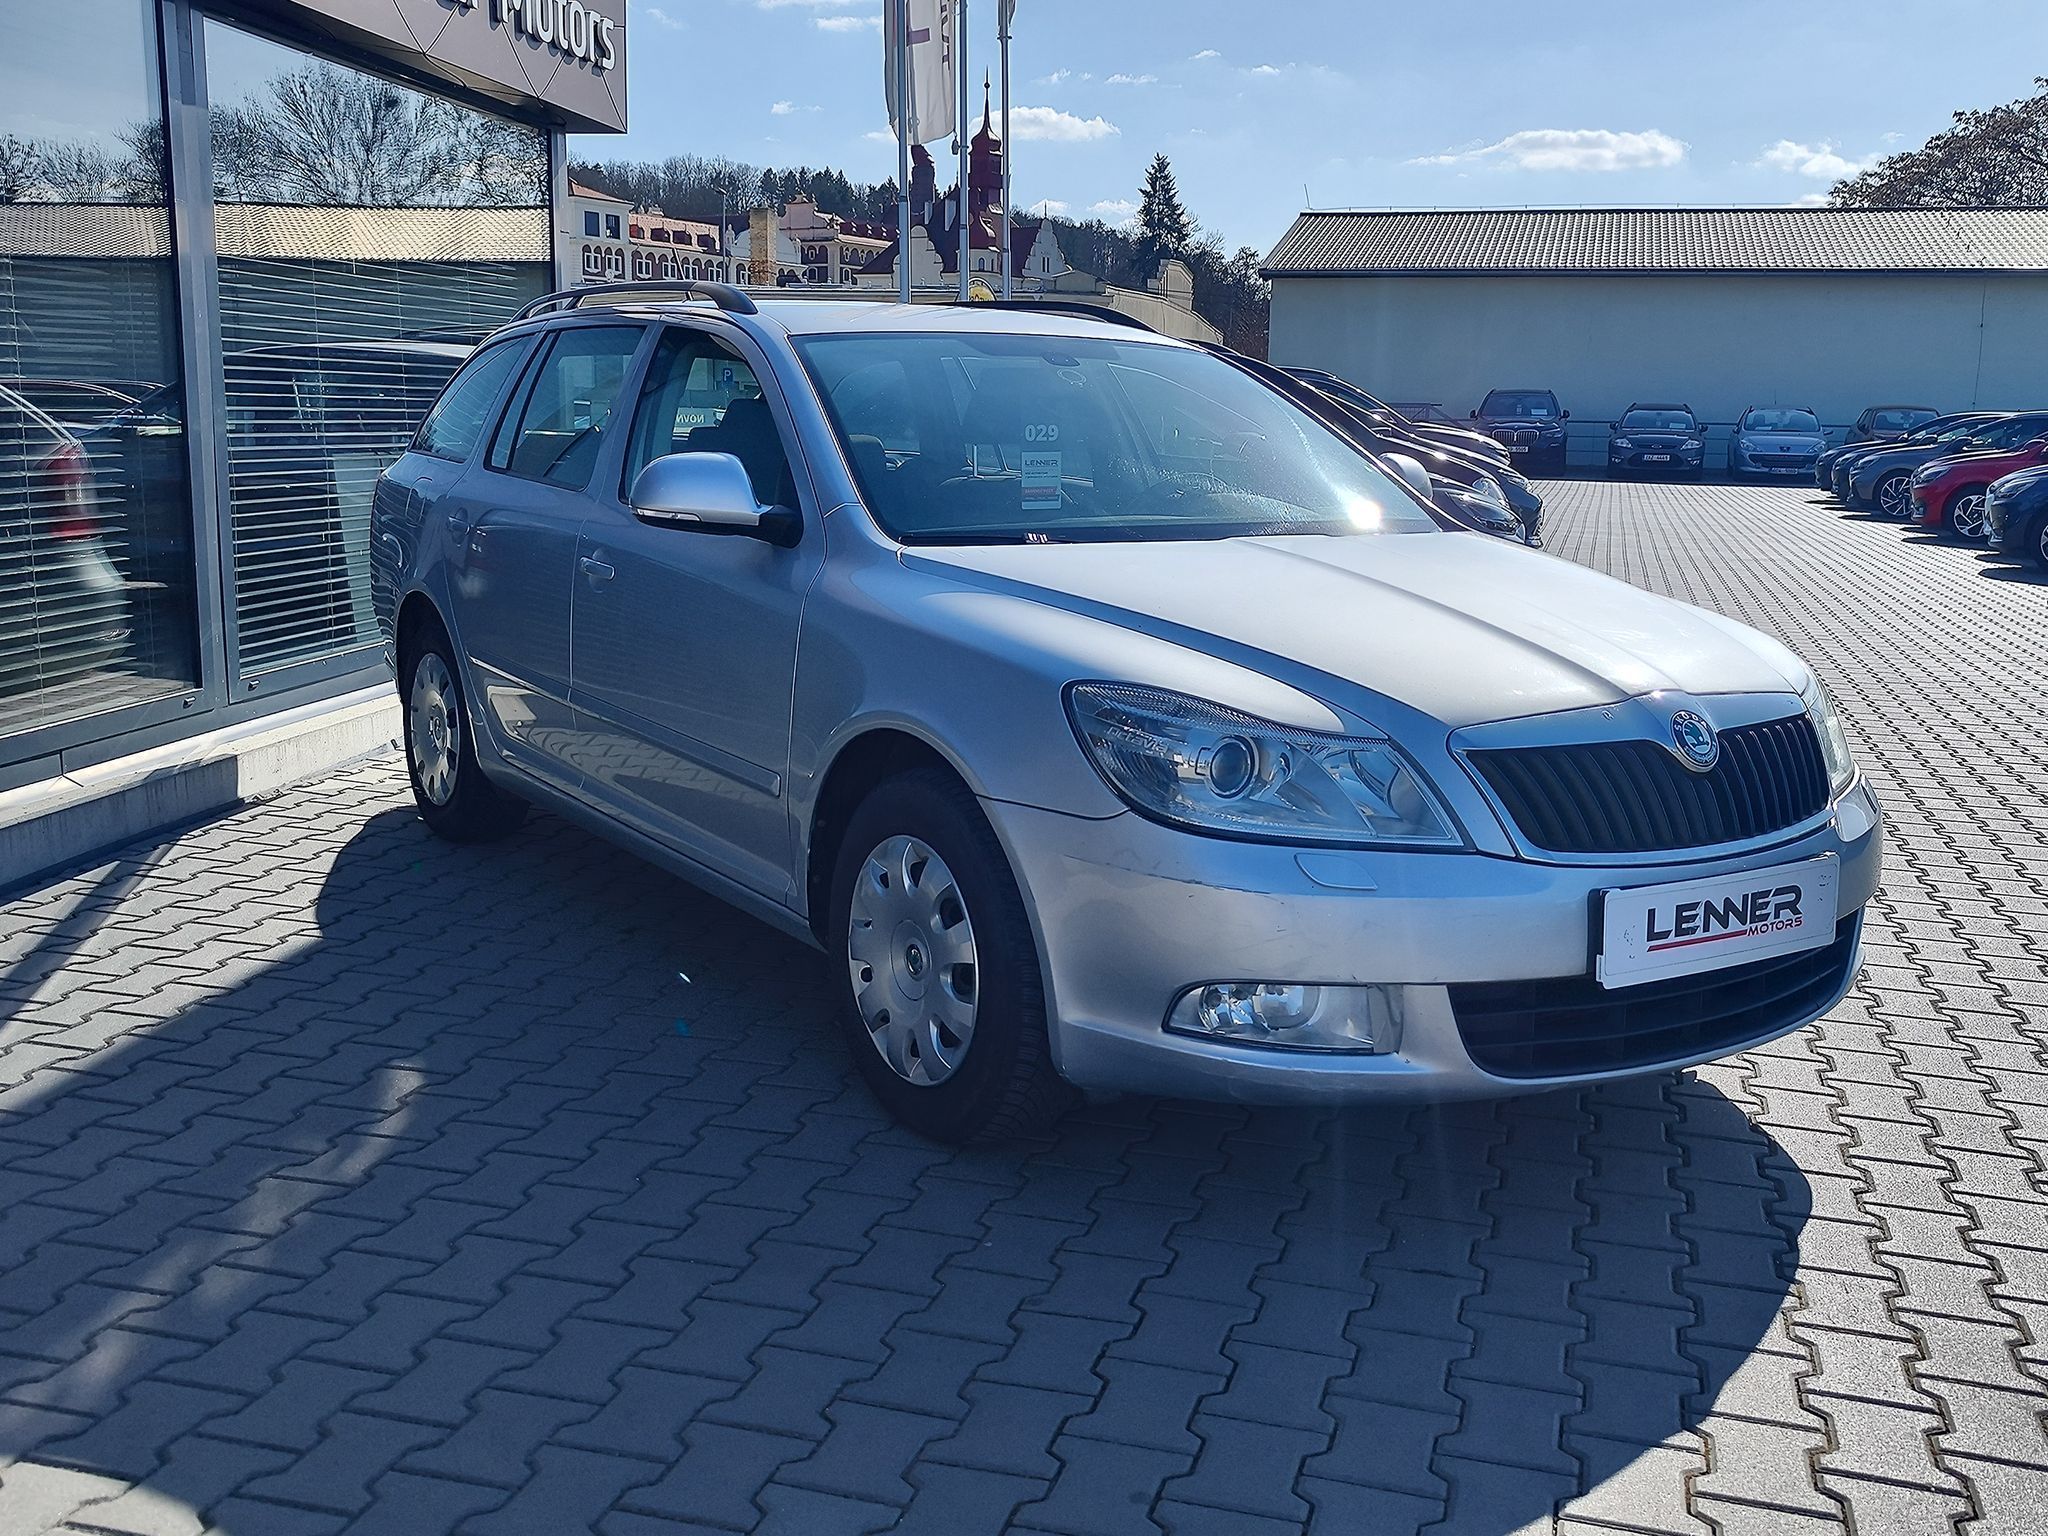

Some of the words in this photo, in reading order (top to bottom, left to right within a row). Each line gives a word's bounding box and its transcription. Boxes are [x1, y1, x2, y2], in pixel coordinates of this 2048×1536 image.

[724, 369, 732, 381] P
[1024, 424, 1059, 441] 029
[1646, 884, 1803, 943] LENNER
[1747, 916, 1803, 937] MOTORS
